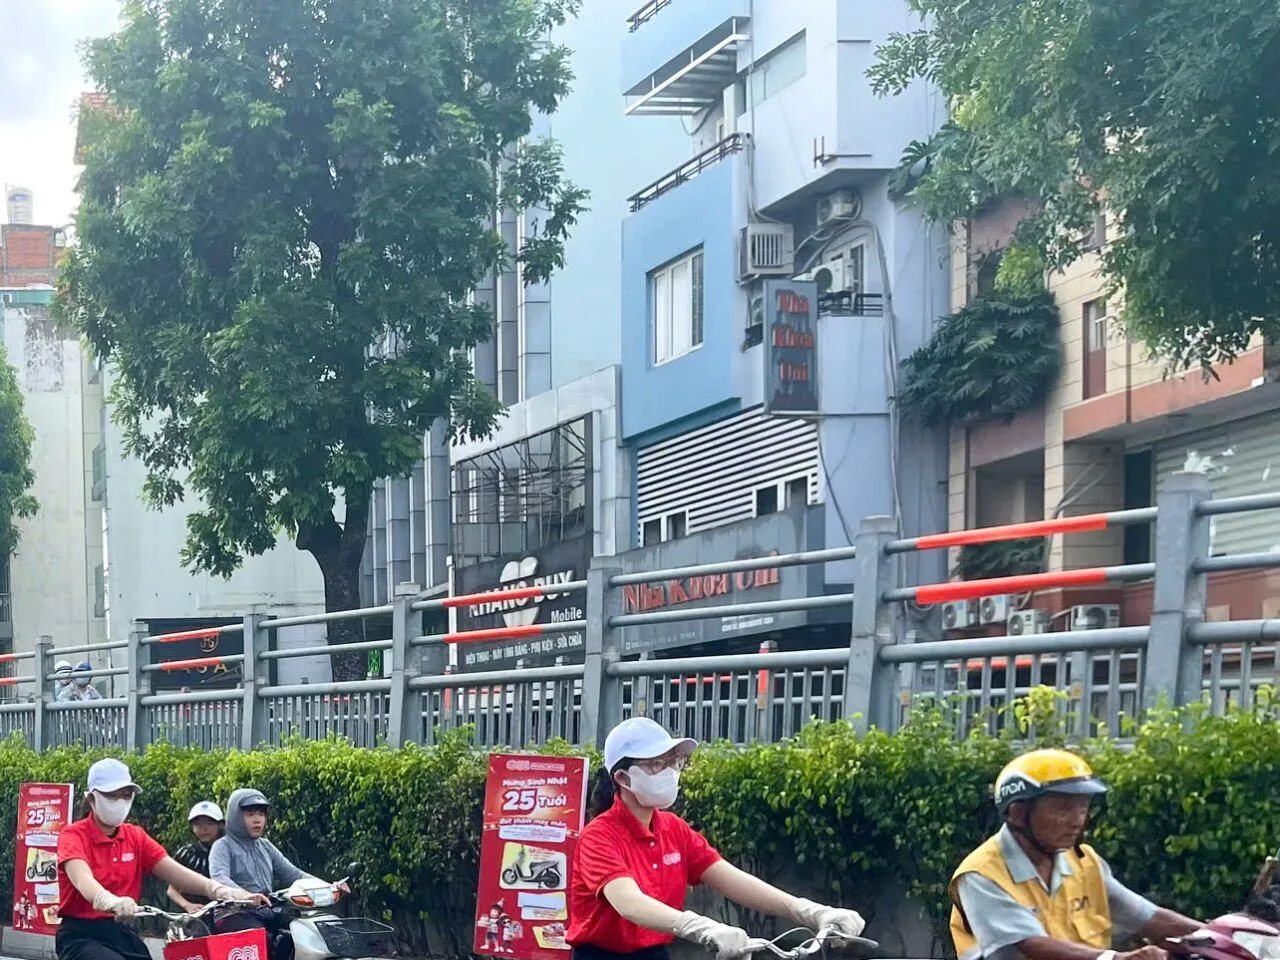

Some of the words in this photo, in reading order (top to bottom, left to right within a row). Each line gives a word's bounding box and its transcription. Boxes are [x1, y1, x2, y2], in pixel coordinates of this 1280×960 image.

[624, 582, 665, 612] Nha
[551, 607, 582, 623] Mobile
[503, 789, 536, 812] 25
[538, 793, 567, 808] Tuổi
[27, 809, 45, 825] 25
